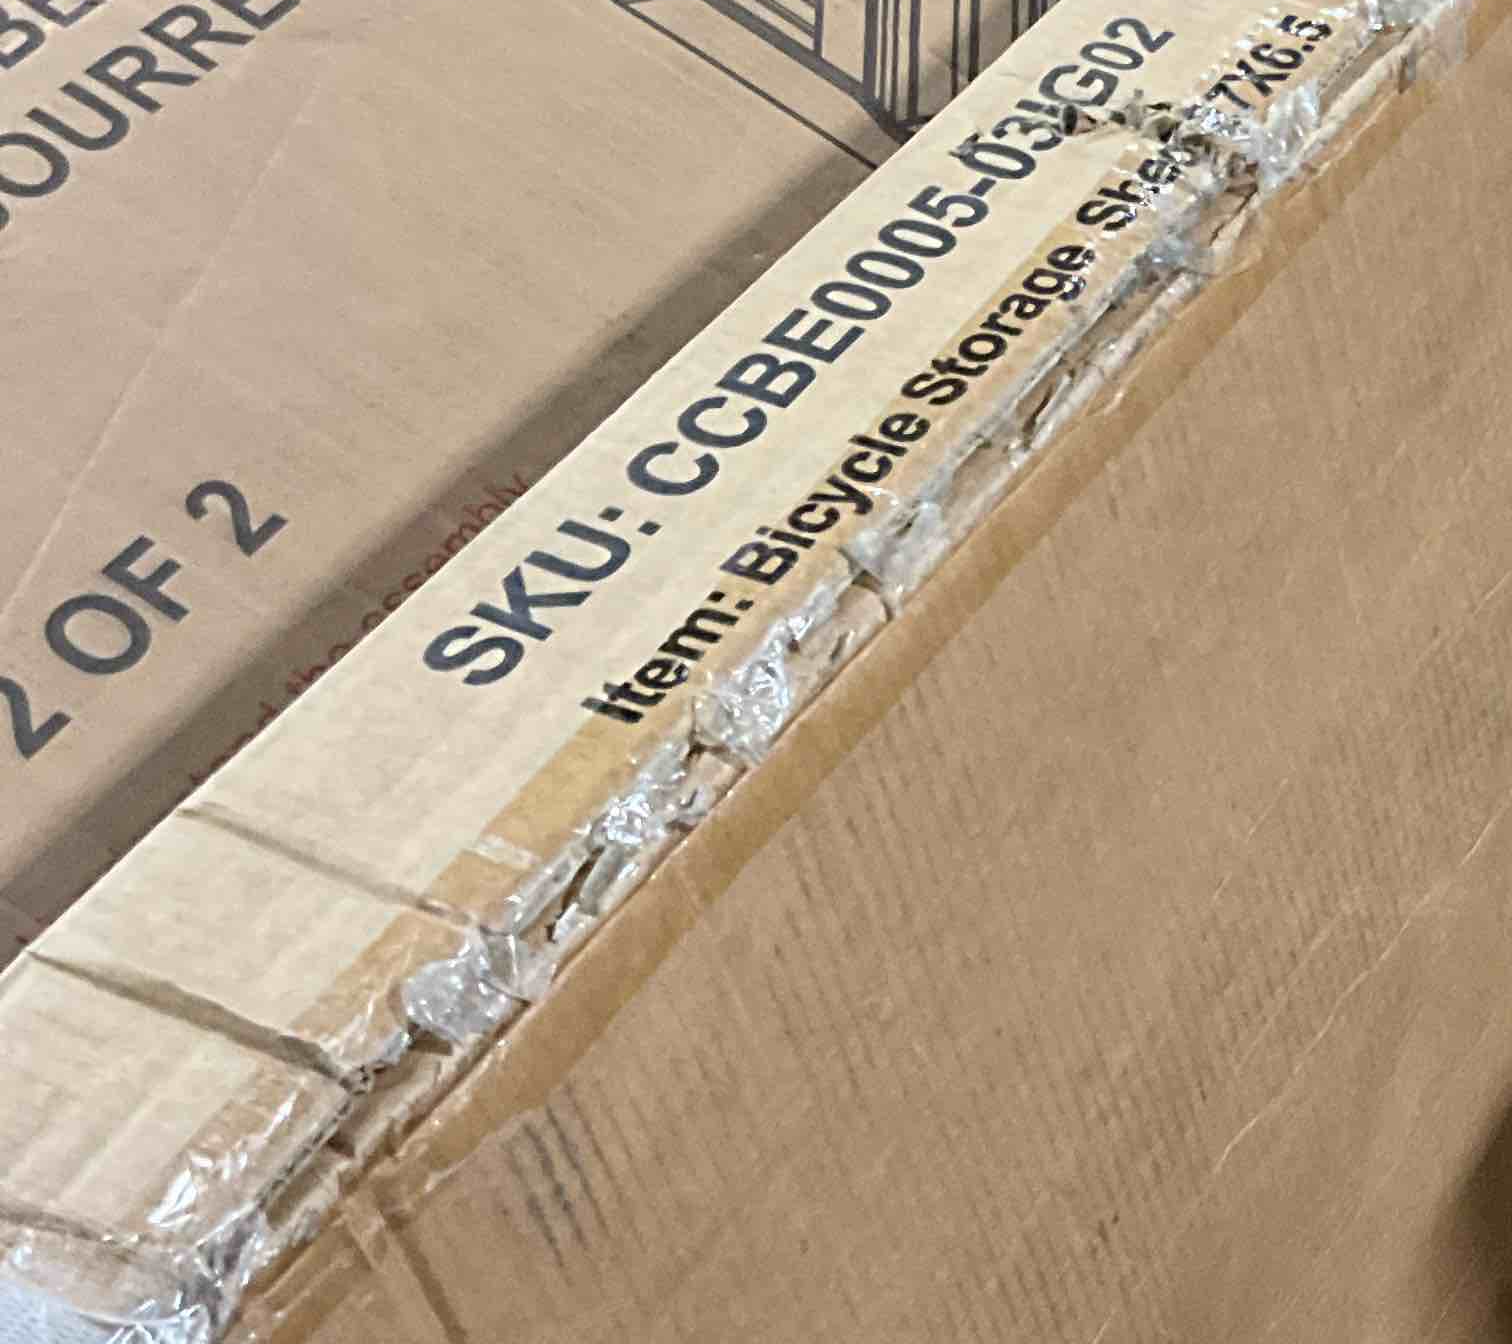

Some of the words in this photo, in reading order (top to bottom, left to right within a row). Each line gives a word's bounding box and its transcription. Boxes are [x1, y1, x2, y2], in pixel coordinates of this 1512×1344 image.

[44, 534, 191, 676] OF
[184, 479, 289, 558] 2
[580, 592, 754, 727] Item:
[718, 400, 934, 587] Bicycle
[921, 234, 1096, 409] Storage
[421, 502, 663, 690] SKU:
